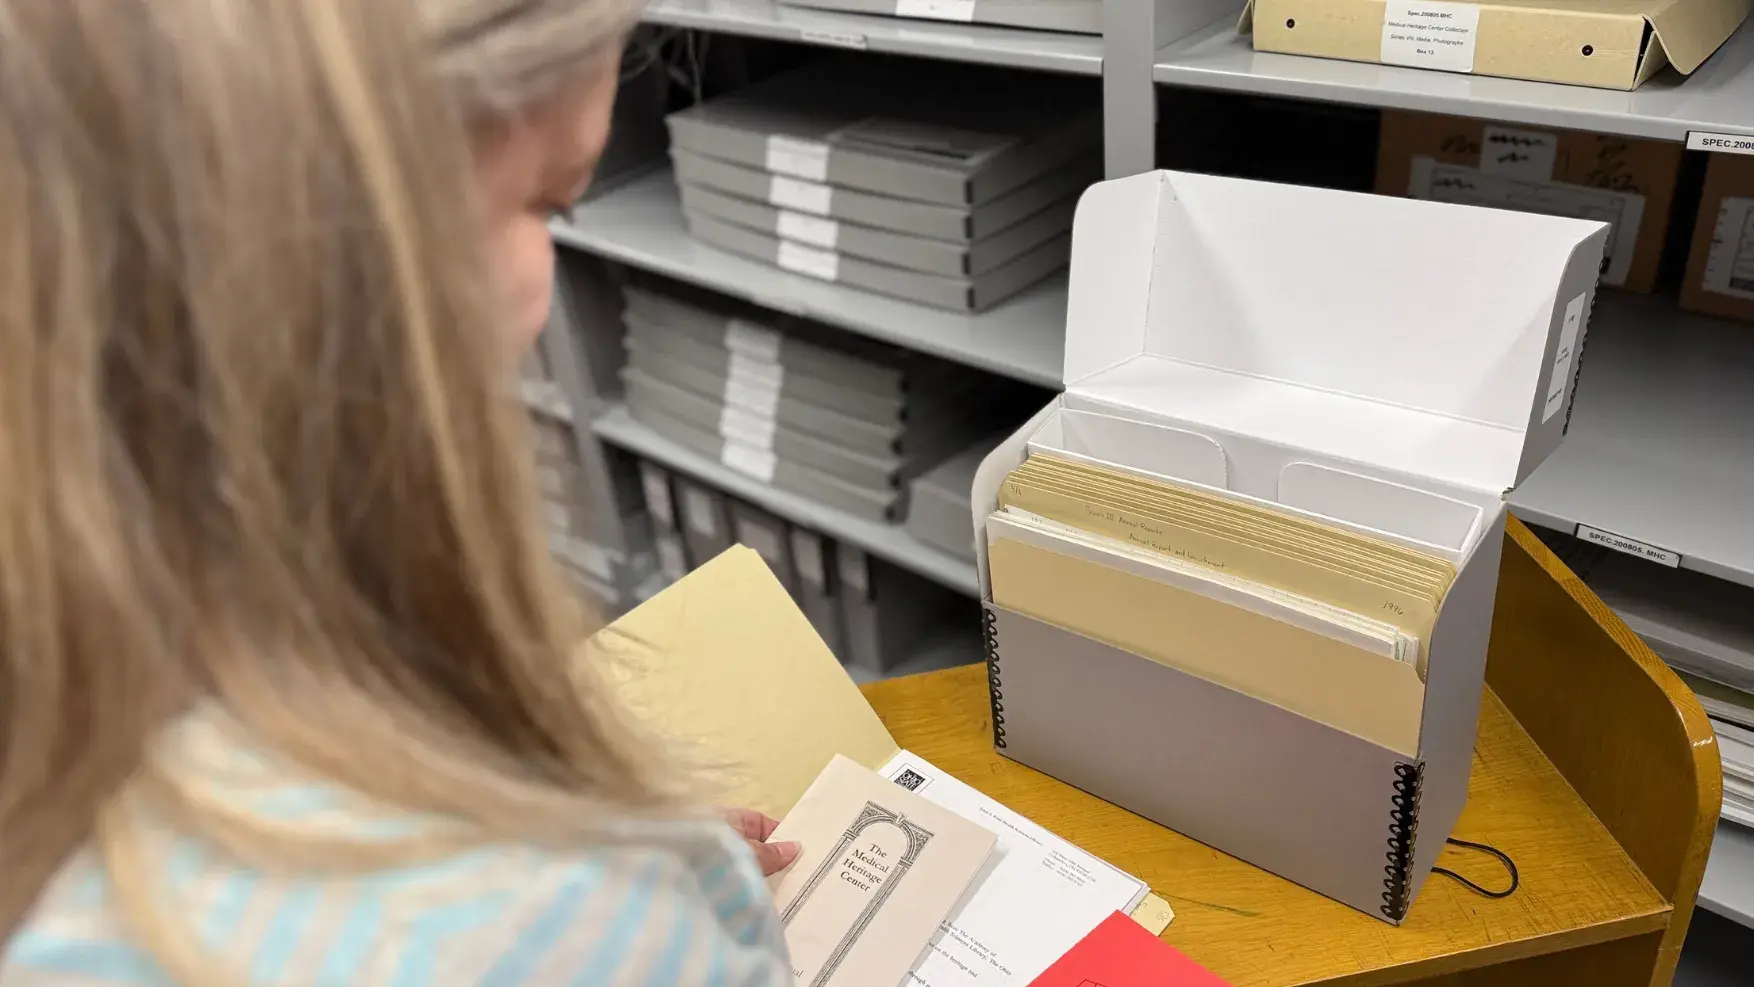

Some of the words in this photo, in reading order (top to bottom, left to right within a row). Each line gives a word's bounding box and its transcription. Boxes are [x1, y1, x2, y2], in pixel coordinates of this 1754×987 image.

[1407, 22, 1427, 30] Heritage
[1432, 38, 1464, 46] Photographs
[1646, 550, 1666, 560] MHC
[1382, 600, 1403, 616] 1996
[852, 848, 890, 874] Medical
[869, 843, 888, 858] The
[840, 870, 871, 892] Center
[843, 858, 882, 884] Heritage
[960, 930, 968, 938] The
[970, 936, 989, 954] Academy
[941, 950, 950, 958] the
[949, 956, 968, 971] heritage
[967, 968, 979, 978] and
[949, 932, 969, 947] Sciences
[989, 958, 998, 968] The
[999, 965, 1012, 976] Ohio
